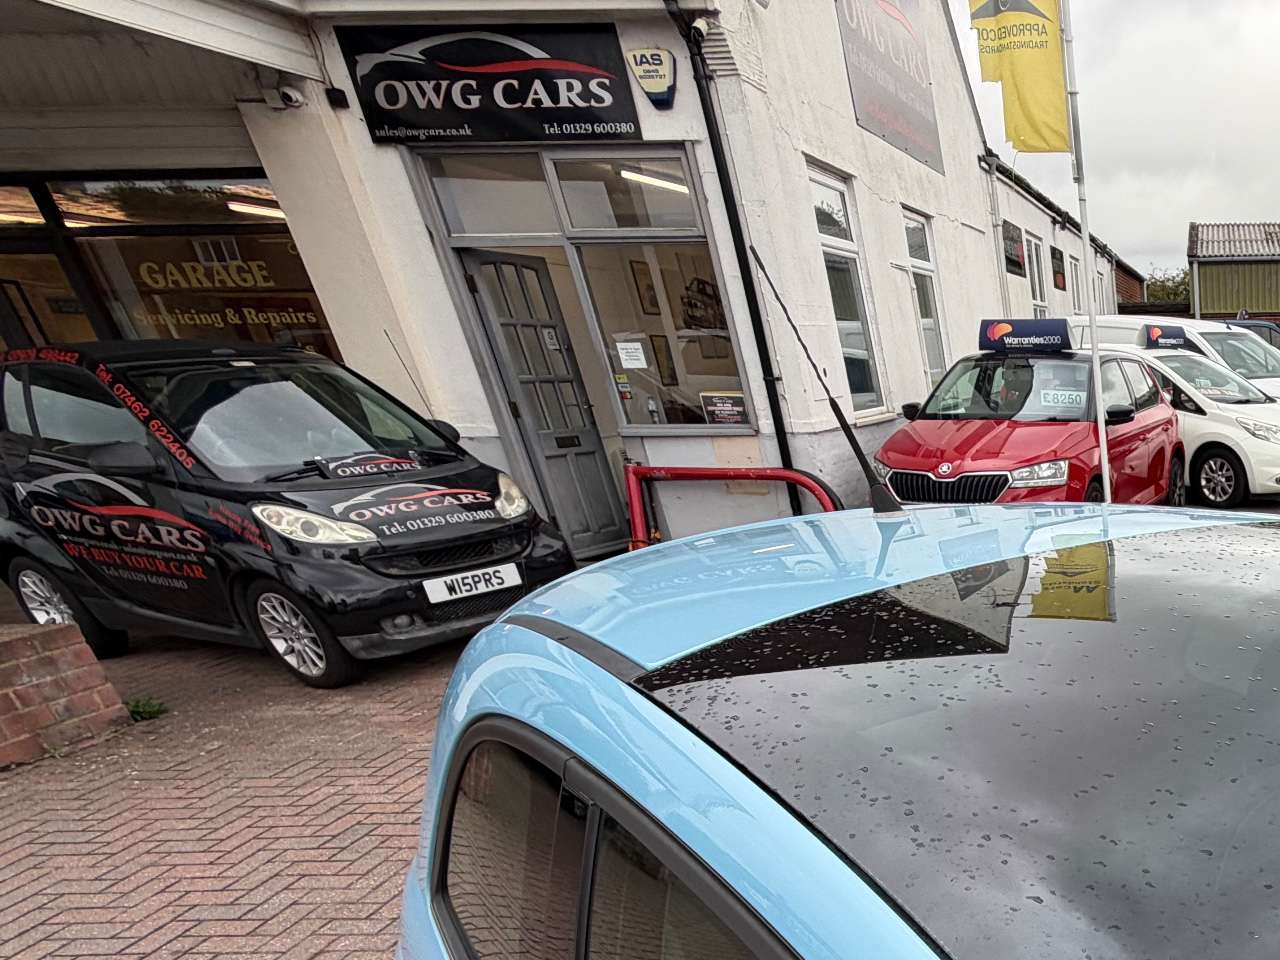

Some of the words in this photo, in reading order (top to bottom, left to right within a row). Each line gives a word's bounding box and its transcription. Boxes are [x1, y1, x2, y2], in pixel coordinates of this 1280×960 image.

[632, 53, 663, 66] IAS
[374, 79, 482, 110] OWG
[492, 78, 614, 108] CARS
[375, 124, 473, 139] sales@owgcars.co.uk
[543, 123, 562, 134] Tel:
[563, 123, 592, 134] 01329
[593, 122, 635, 134] 600380
[139, 260, 275, 289] GARAGE
[136, 308, 225, 328] Servicing
[225, 308, 243, 324] &
[245, 307, 317, 327] Repairs
[1003, 335, 1061, 345] Warranties2000
[113, 383, 150, 420] 07462
[337, 463, 379, 477] OWG
[380, 461, 422, 473] CARS
[349, 499, 418, 522] OWG
[423, 491, 493, 510] CARS
[30, 504, 105, 537] OWG
[110, 520, 206, 552] CARS
[379, 522, 407, 537] Tel:
[407, 516, 446, 533] 01329
[447, 509, 495, 525] 600380
[121, 552, 168, 574] YOUR
[170, 562, 208, 580] CAR
